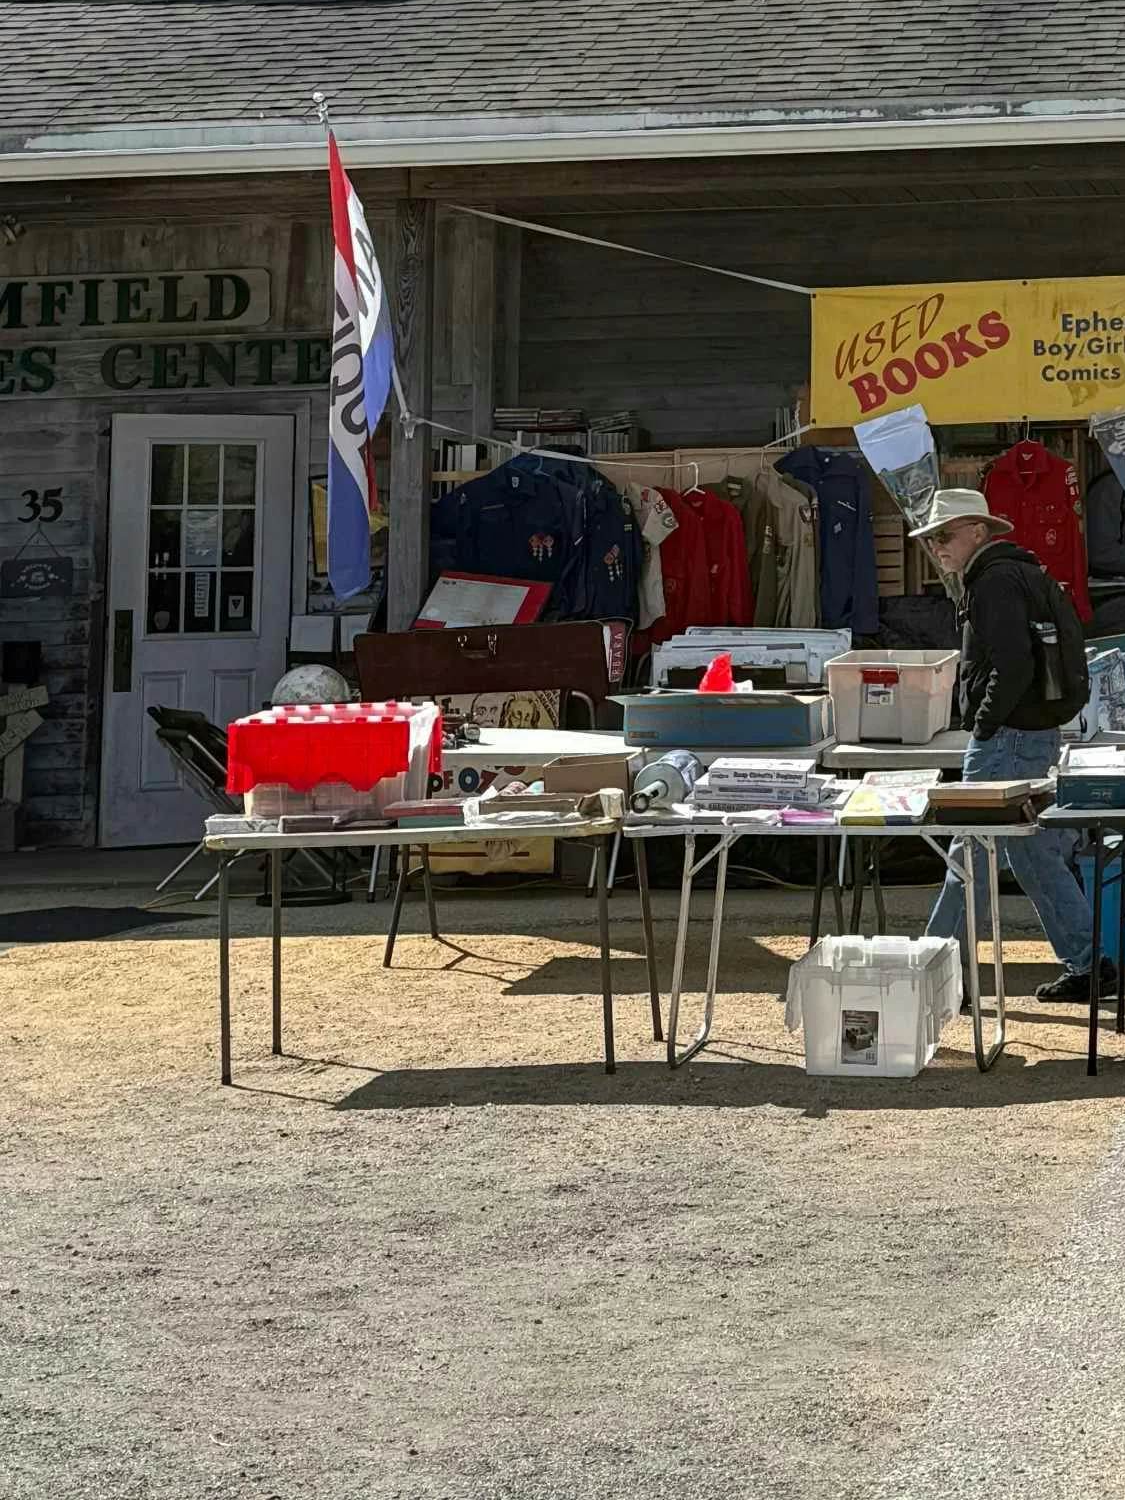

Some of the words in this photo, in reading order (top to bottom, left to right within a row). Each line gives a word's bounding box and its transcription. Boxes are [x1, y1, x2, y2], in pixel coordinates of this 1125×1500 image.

[835, 292, 945, 380] USED
[848, 310, 1011, 414] BOOKS
[101, 337, 331, 391] CENTE
[1041, 362, 1121, 382] Comics
[17, 486, 64, 524] 35
